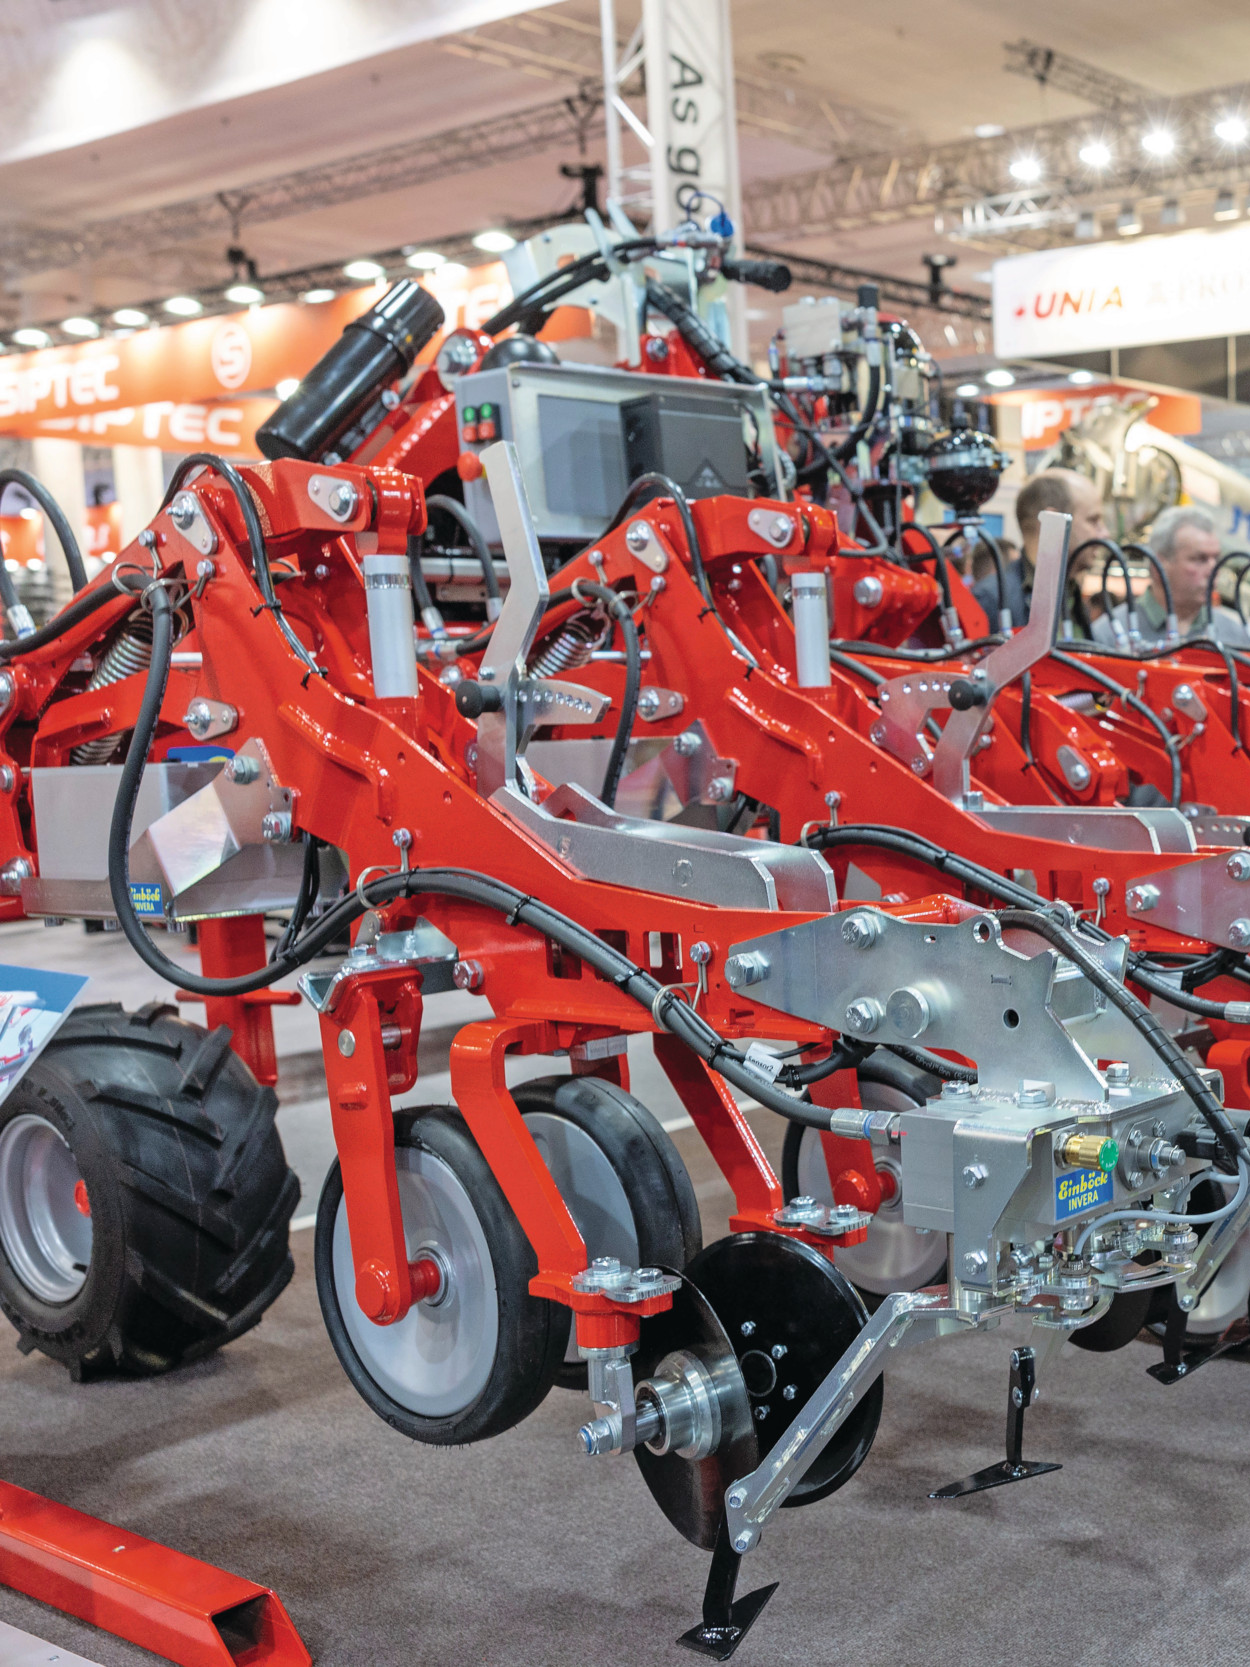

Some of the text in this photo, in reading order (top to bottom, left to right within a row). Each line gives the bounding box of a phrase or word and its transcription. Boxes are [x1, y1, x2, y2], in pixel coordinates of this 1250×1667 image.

[670, 53, 703, 124] As
[1033, 285, 1124, 319] UNIA
[130, 887, 160, 901] inböck
[1058, 1171, 1109, 1201] Einböck
[1068, 1189, 1099, 1212] INVERA
